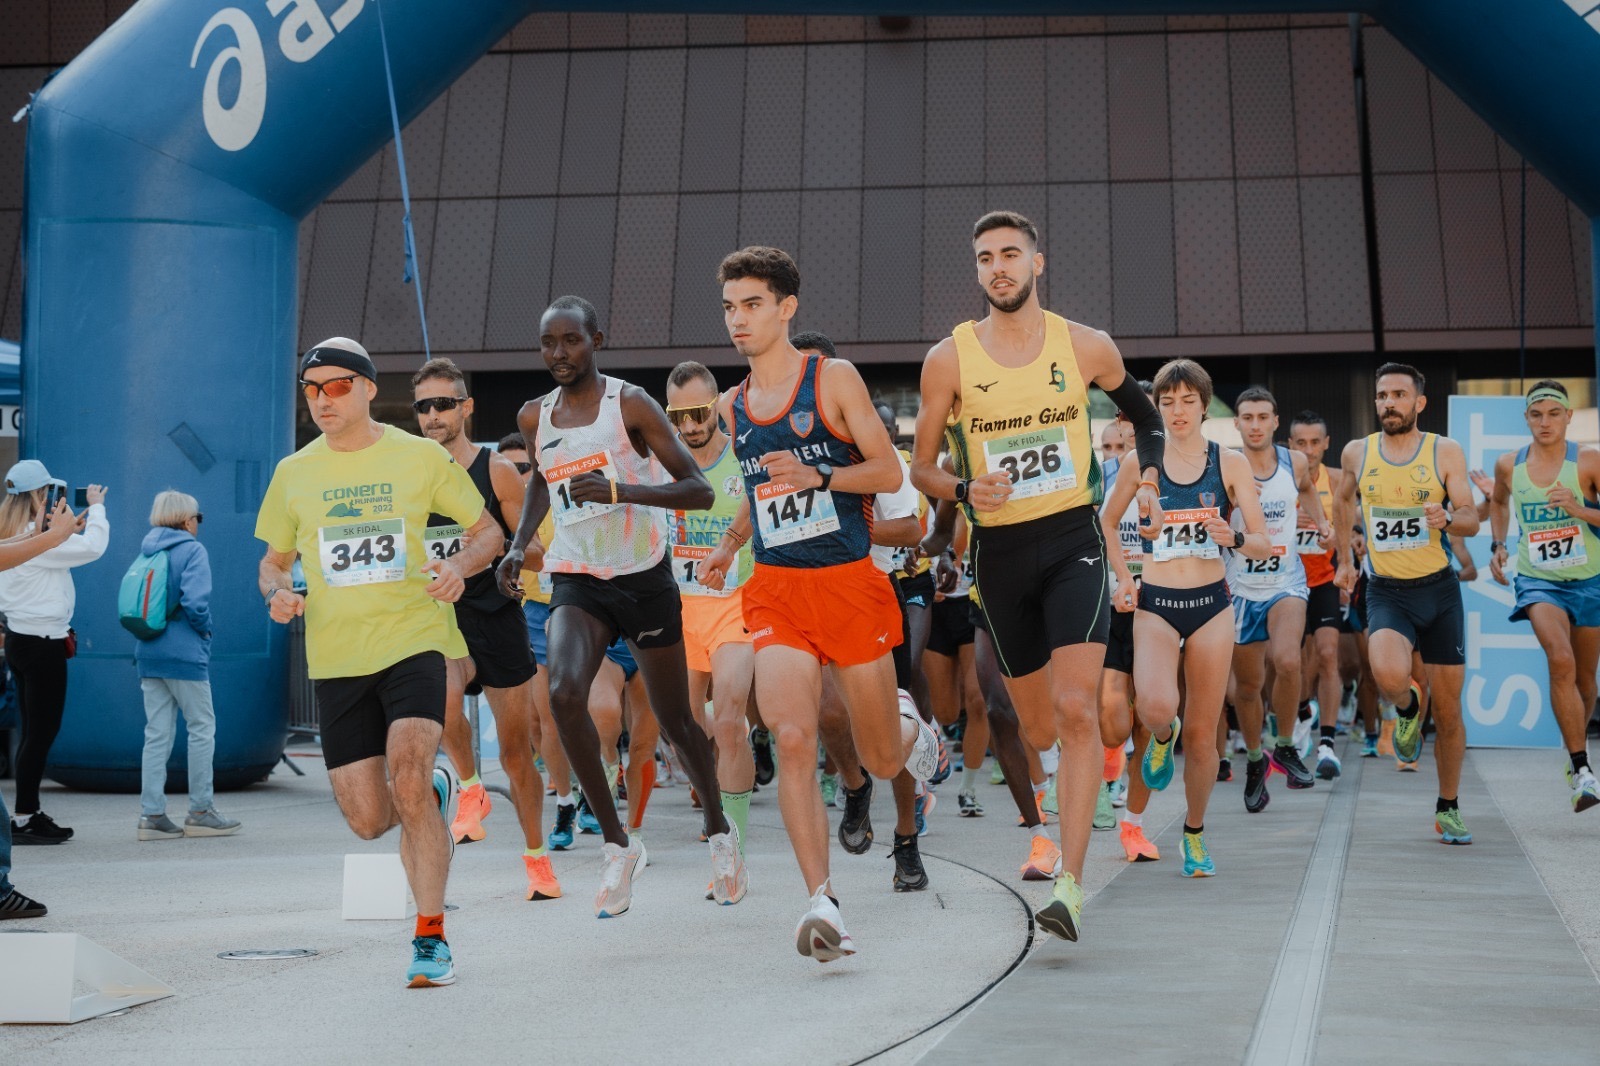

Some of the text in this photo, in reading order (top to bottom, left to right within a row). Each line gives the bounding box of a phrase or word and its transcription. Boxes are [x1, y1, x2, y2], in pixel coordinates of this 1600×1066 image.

[970, 405, 1079, 434] Fiamme Gialle
[1008, 434, 1047, 448] 5K FIDAL
[547, 457, 603, 480] 10K FIDAL-FSAL
[999, 443, 1062, 485] 326
[760, 487, 772, 497] 10K
[373, 504, 394, 514] 2022
[767, 488, 815, 530] 147
[343, 525, 382, 536] 5K FIDAL
[1163, 521, 1208, 548] 148
[1375, 517, 1421, 541] 345
[331, 534, 396, 572] 343
[1537, 536, 1574, 561] 137
[1245, 555, 1281, 573] 123
[1155, 595, 1214, 609] CARABINIERI
